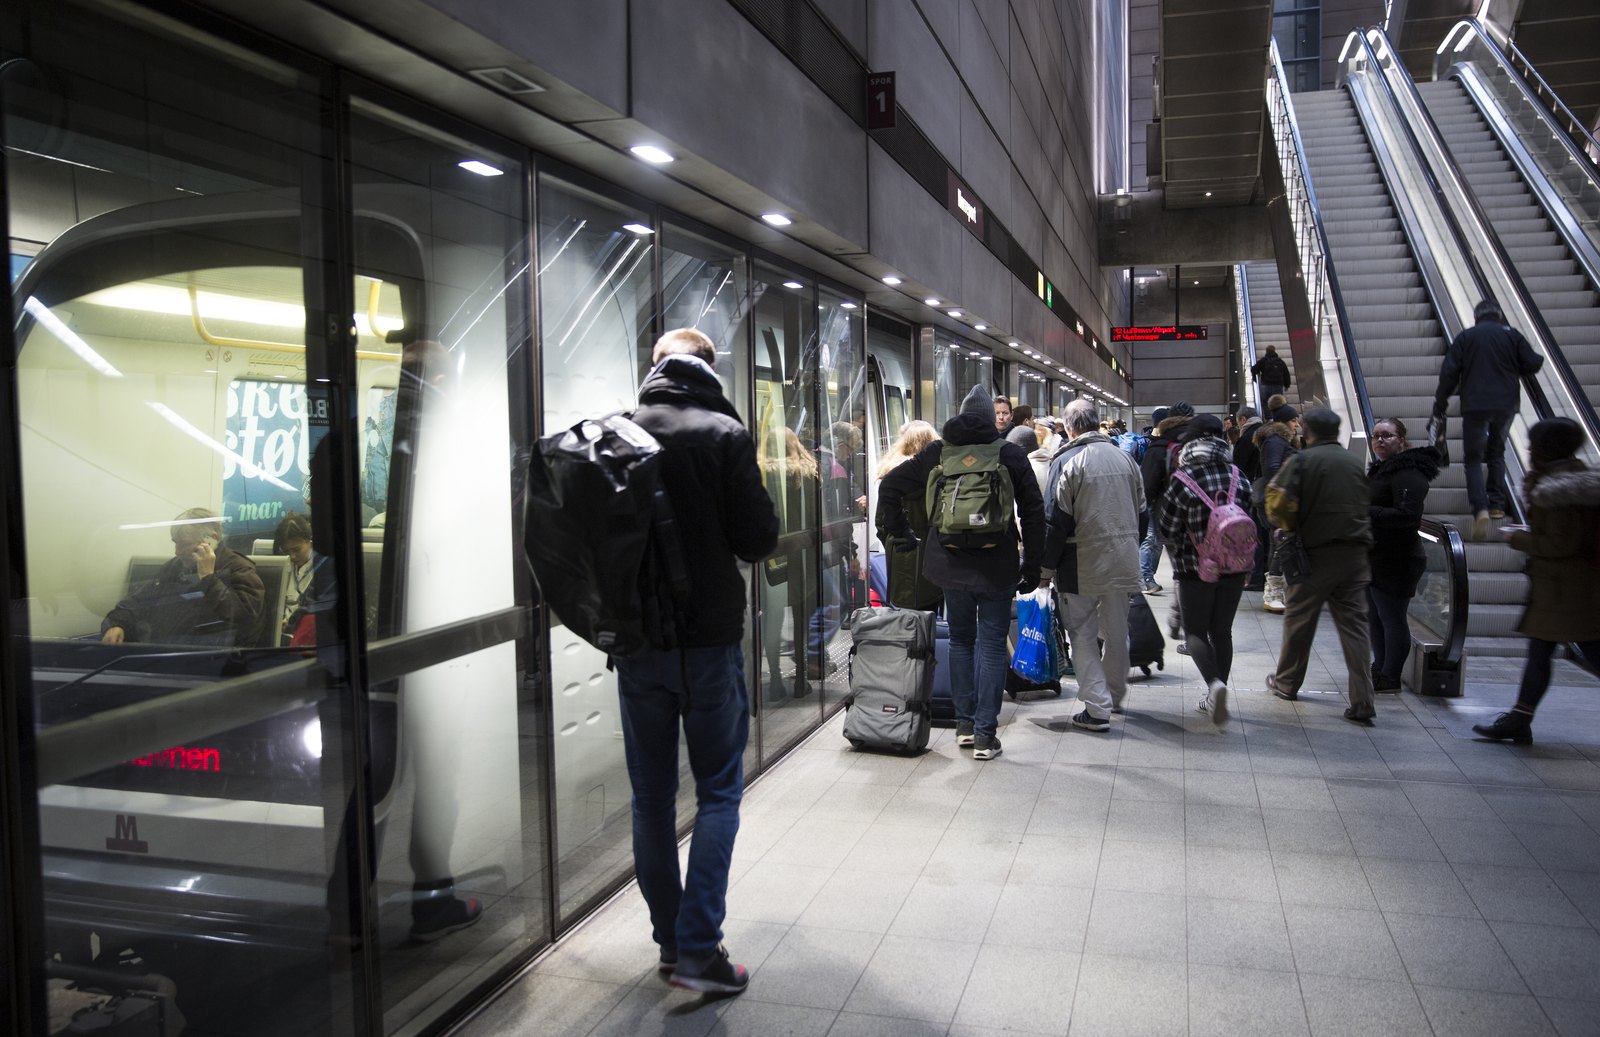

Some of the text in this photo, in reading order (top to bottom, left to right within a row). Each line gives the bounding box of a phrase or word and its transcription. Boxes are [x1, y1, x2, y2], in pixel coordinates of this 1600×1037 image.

[871, 77, 891, 86] SPOR
[875, 91, 886, 113] 1
[238, 501, 286, 522] mar.
